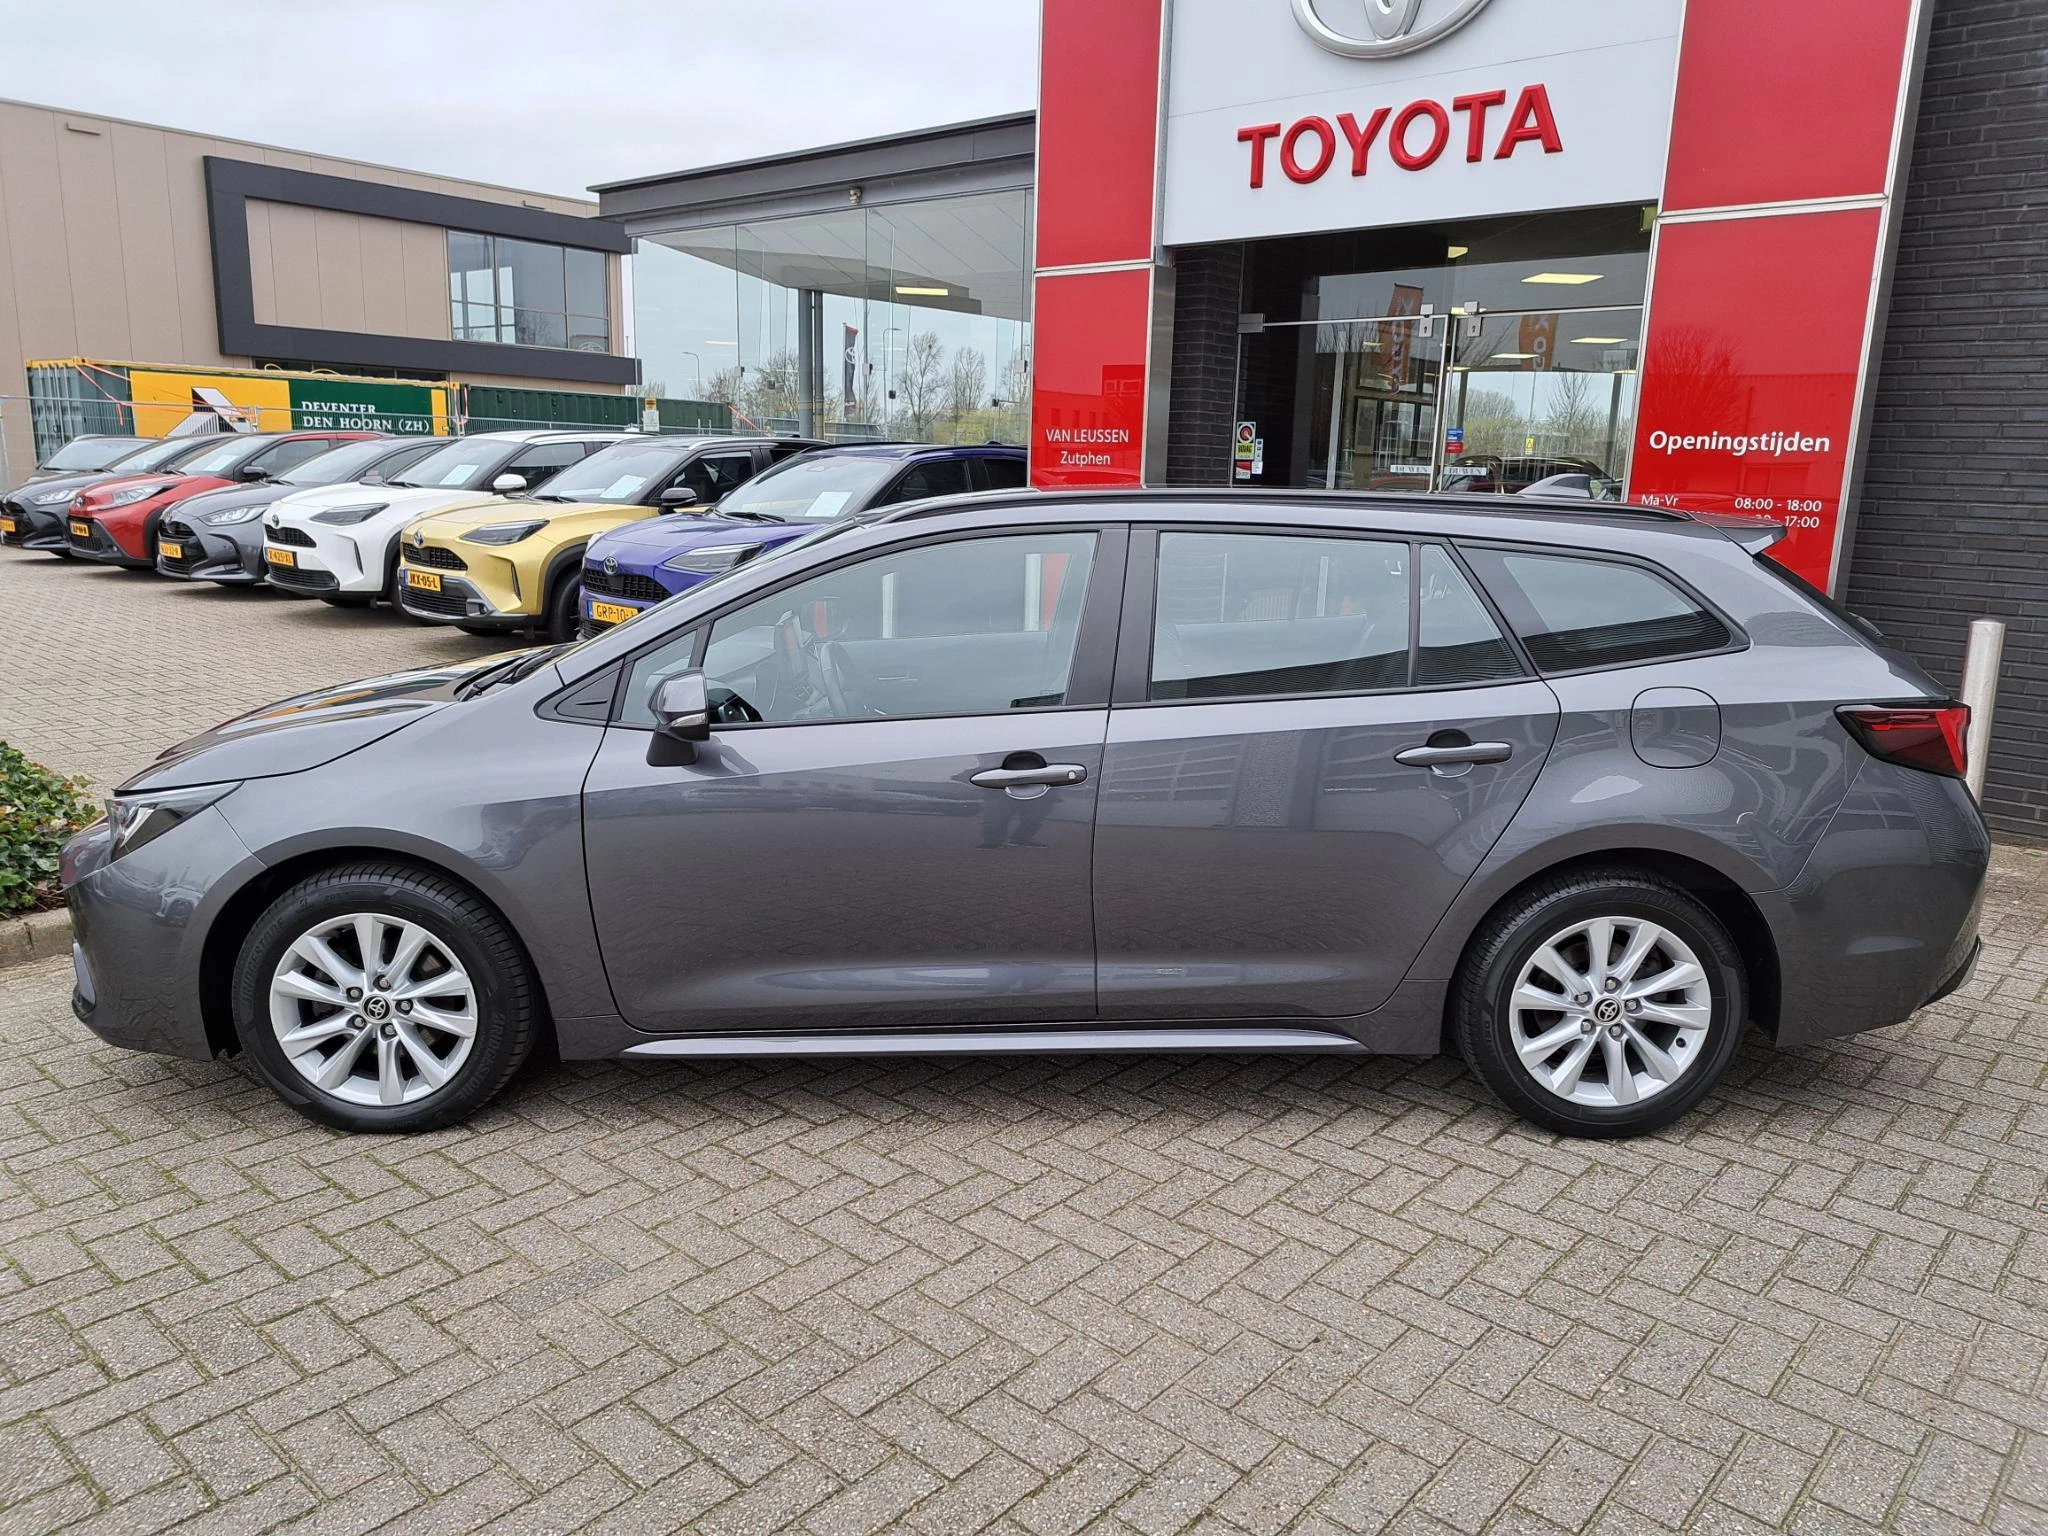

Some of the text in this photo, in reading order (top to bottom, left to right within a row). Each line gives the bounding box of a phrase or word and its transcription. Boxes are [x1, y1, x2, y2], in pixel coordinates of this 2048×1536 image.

[1237, 83, 1563, 189] TOYOTA
[301, 401, 376, 414] DEVENTER
[303, 415, 429, 433] DEN HOORN (ZH)
[1045, 428, 1129, 443] VAN LEUSSEN
[1649, 430, 1830, 457] Openingstijden
[1060, 450, 1111, 468] Zutphen
[1641, 494, 1679, 507] Ma-Vr
[1734, 497, 1773, 510] 08:00
[1786, 499, 1822, 512] 18:00
[1785, 515, 1820, 529] 17:00
